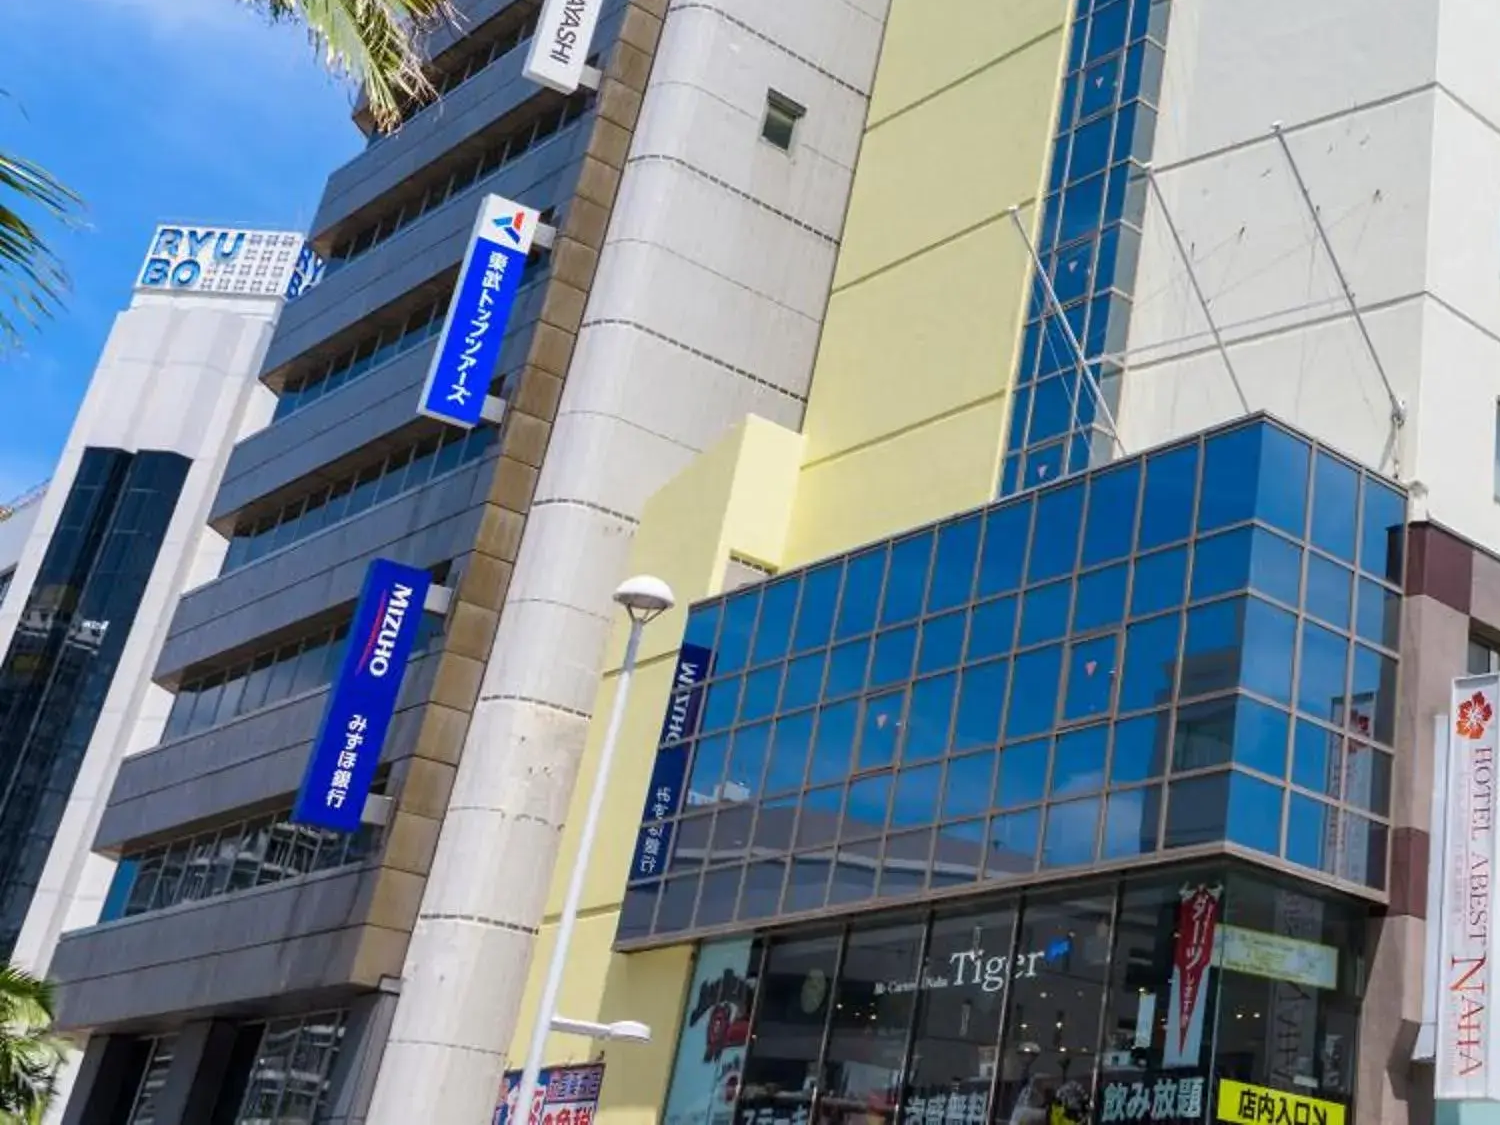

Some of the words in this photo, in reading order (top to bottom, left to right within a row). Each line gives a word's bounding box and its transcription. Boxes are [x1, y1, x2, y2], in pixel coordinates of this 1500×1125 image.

[151, 228, 246, 261] RYU
[141, 257, 202, 289] BO
[369, 582, 413, 678] MIZUHO
[326, 714, 367, 809] みずほ銀行
[1472, 746, 1493, 841] HOTEL
[1470, 852, 1488, 949] ABEST
[950, 949, 1045, 991] Tiger
[1102, 1077, 1204, 1122] 飲み放題
[1238, 1089, 1311, 1125] 店内入口
